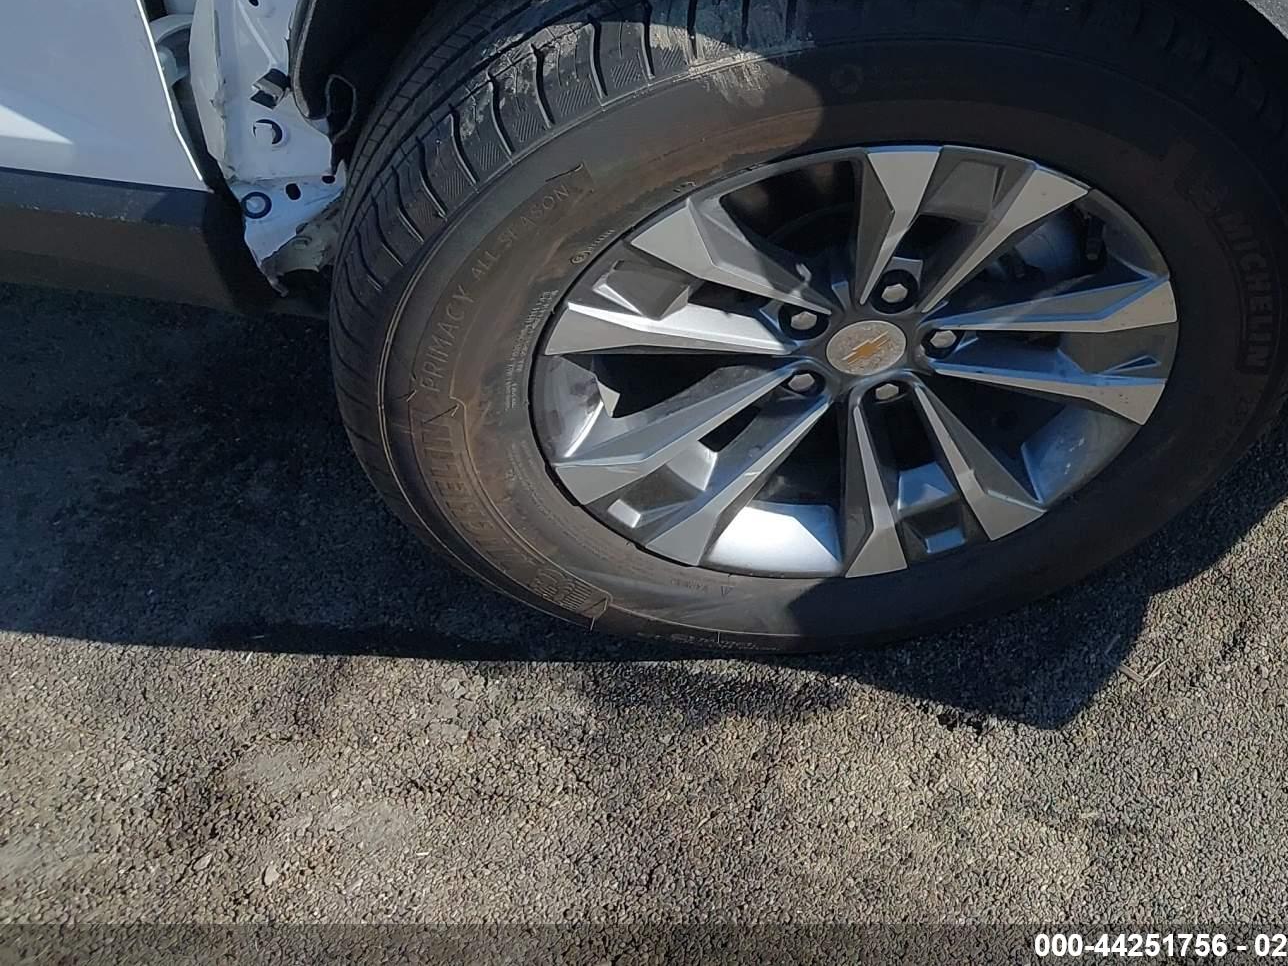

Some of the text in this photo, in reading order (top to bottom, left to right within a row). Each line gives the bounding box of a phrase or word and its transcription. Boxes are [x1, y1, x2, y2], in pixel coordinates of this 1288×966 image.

[421, 283, 474, 393] PRIMACY
[471, 248, 498, 283] ALL
[1217, 210, 1273, 367] MICHELIN
